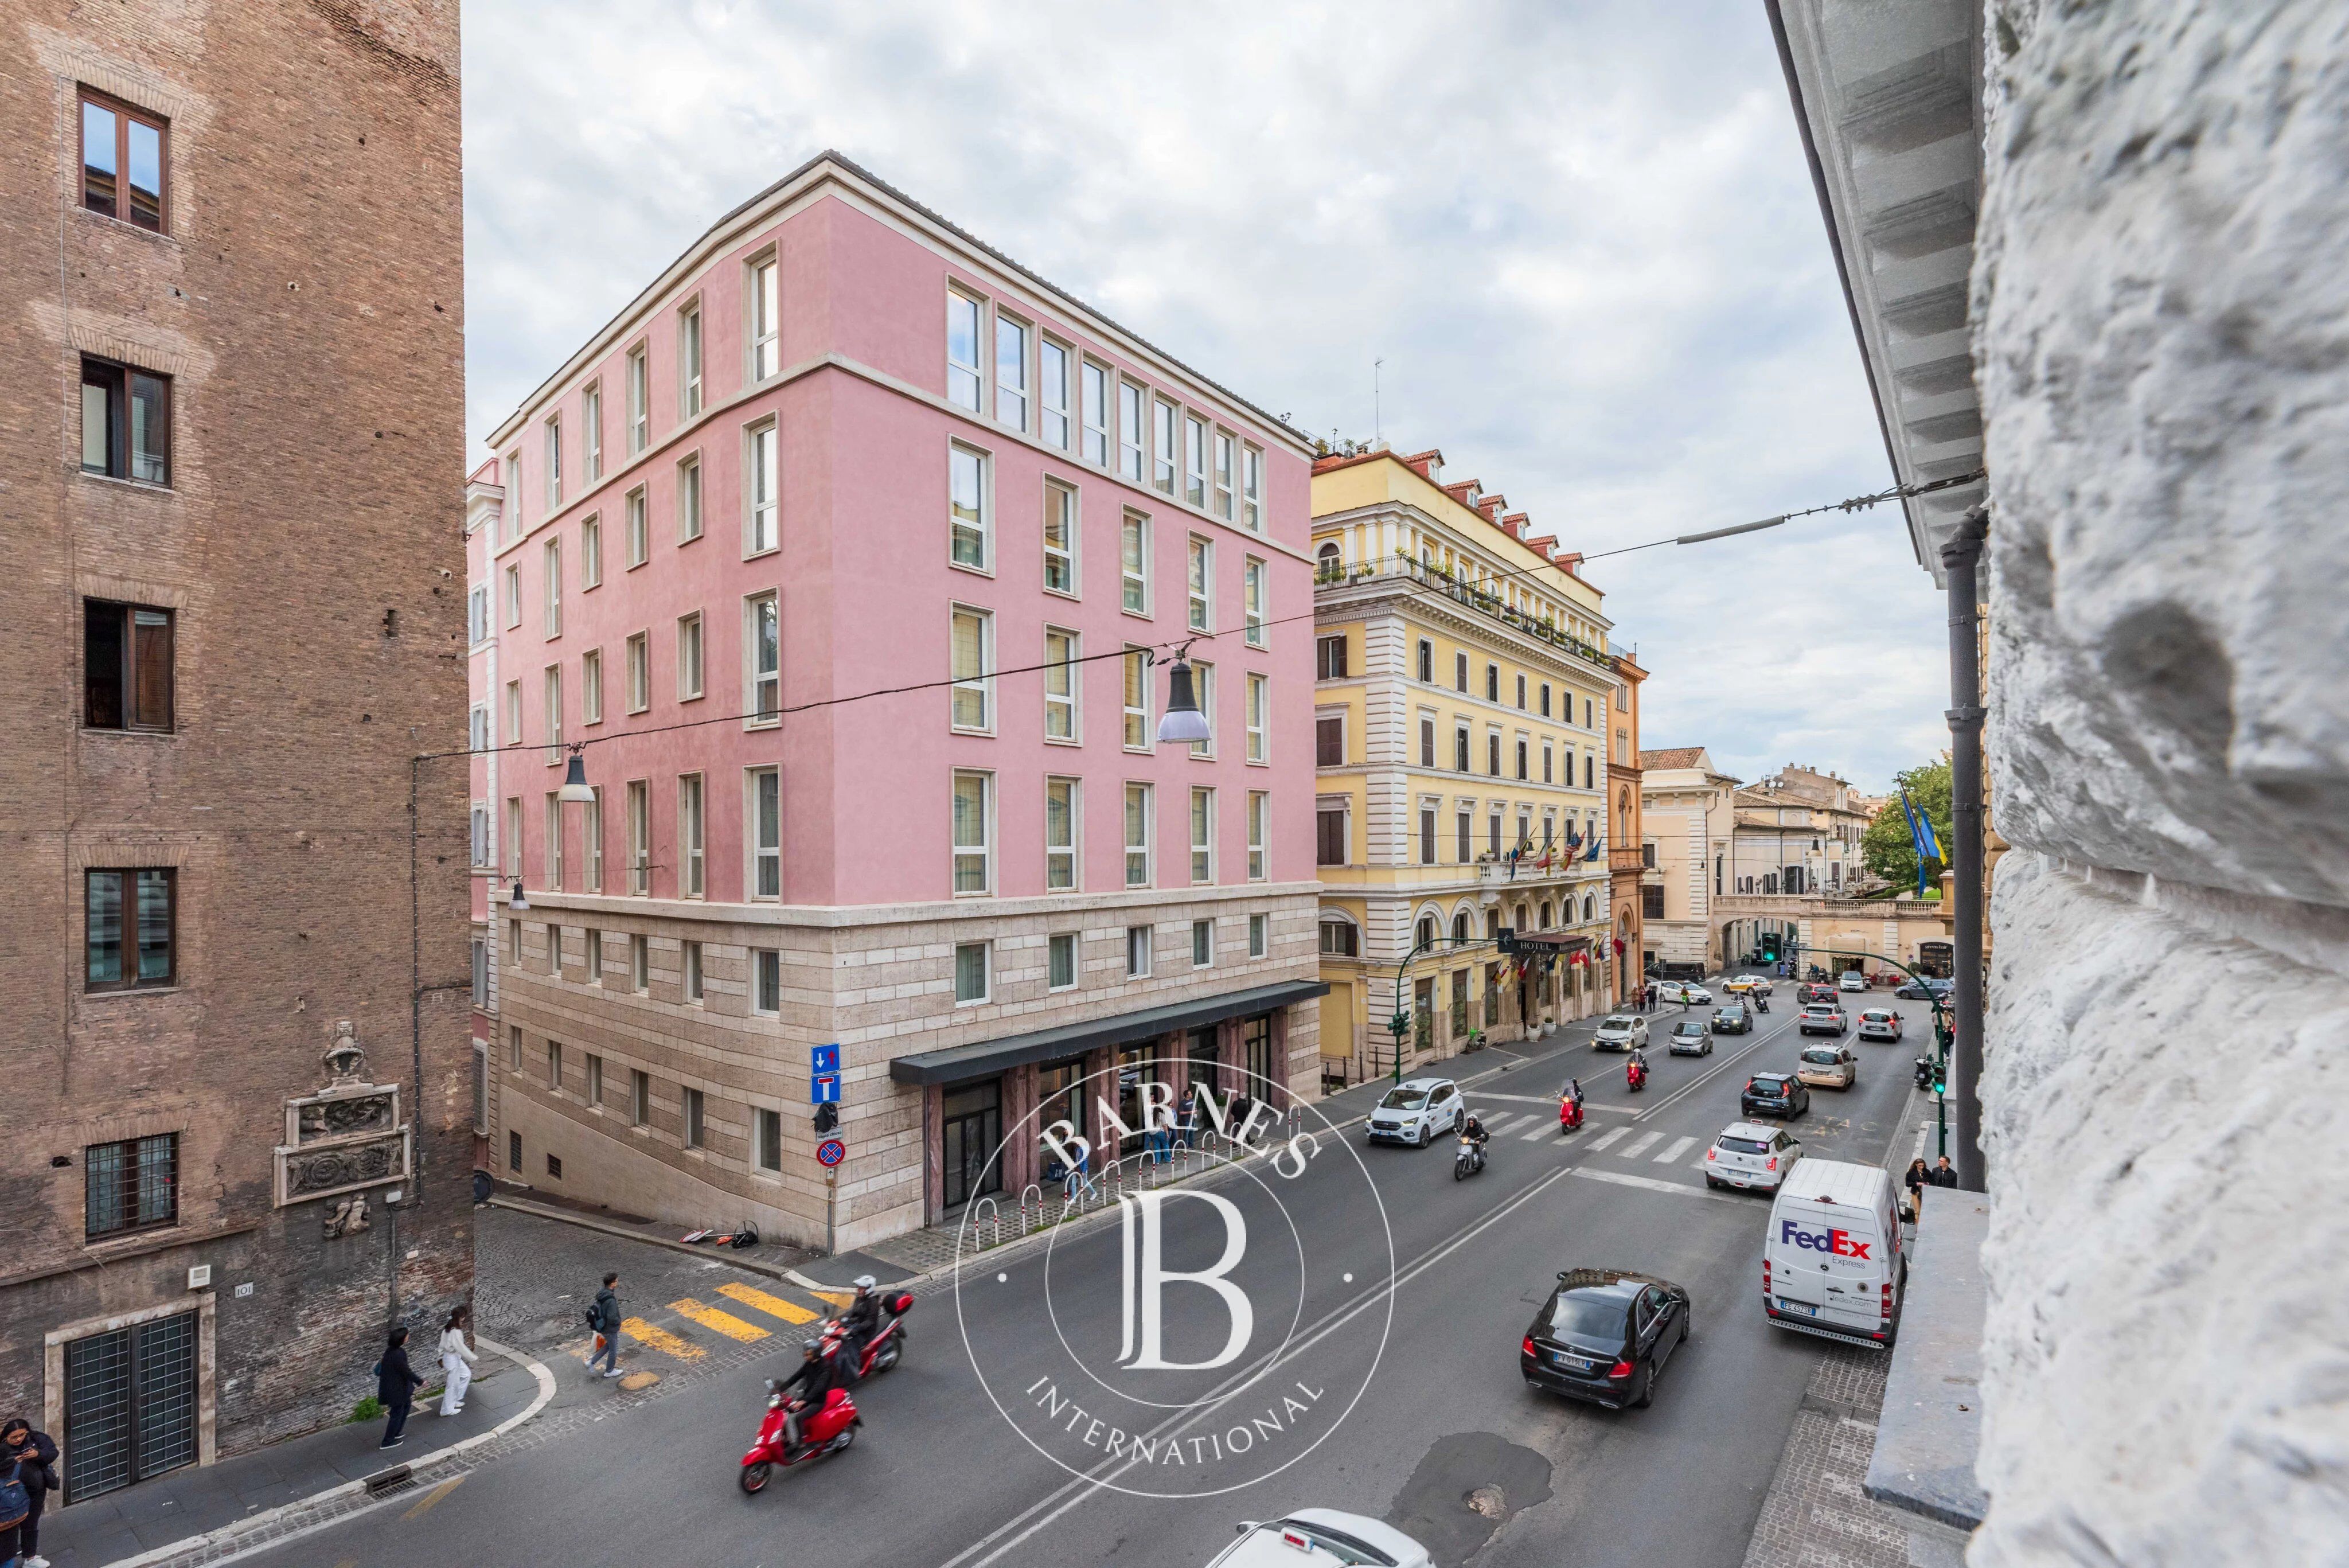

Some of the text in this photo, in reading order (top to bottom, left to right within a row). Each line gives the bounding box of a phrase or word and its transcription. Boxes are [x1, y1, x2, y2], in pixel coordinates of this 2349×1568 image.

[1520, 942, 1552, 950] HOTEL
[1782, 1220, 1871, 1261] FedEx
[1832, 1255, 1866, 1269] Express
[237, 1286, 251, 1296] 101
[1832, 1294, 1872, 1308] fedex.com
